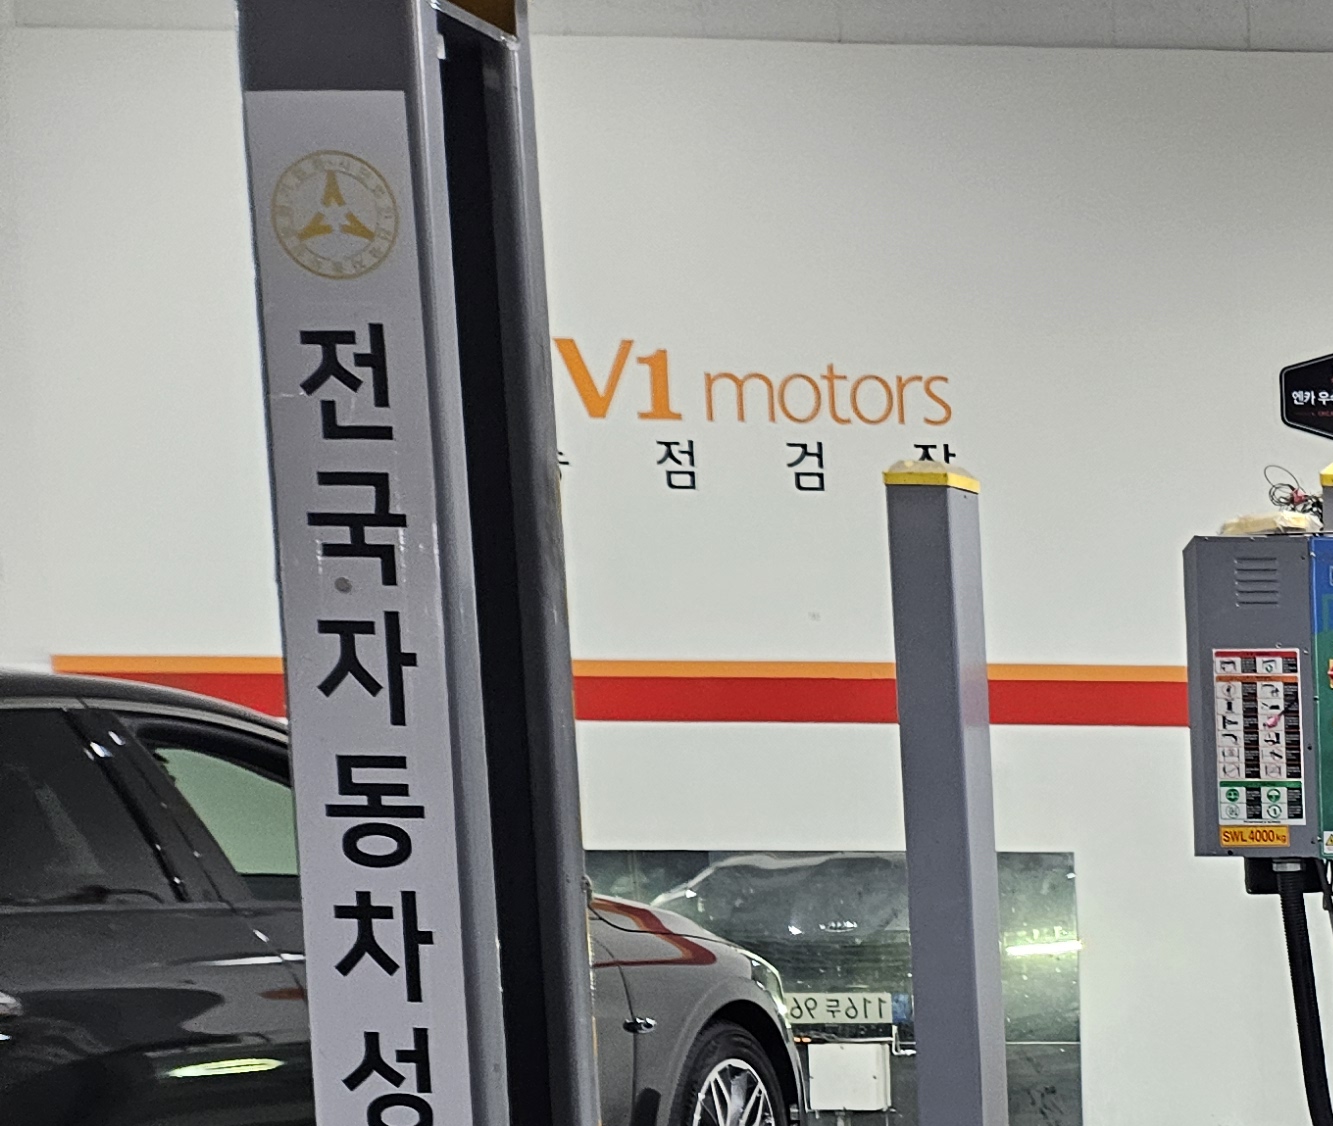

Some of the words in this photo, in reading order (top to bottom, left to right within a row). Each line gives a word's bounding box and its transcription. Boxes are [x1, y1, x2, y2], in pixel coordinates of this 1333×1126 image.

[553, 337, 683, 420] V1
[704, 363, 953, 426] motors
[1292, 390, 1315, 406] 엔카
[1223, 831, 1247, 842] SWL
